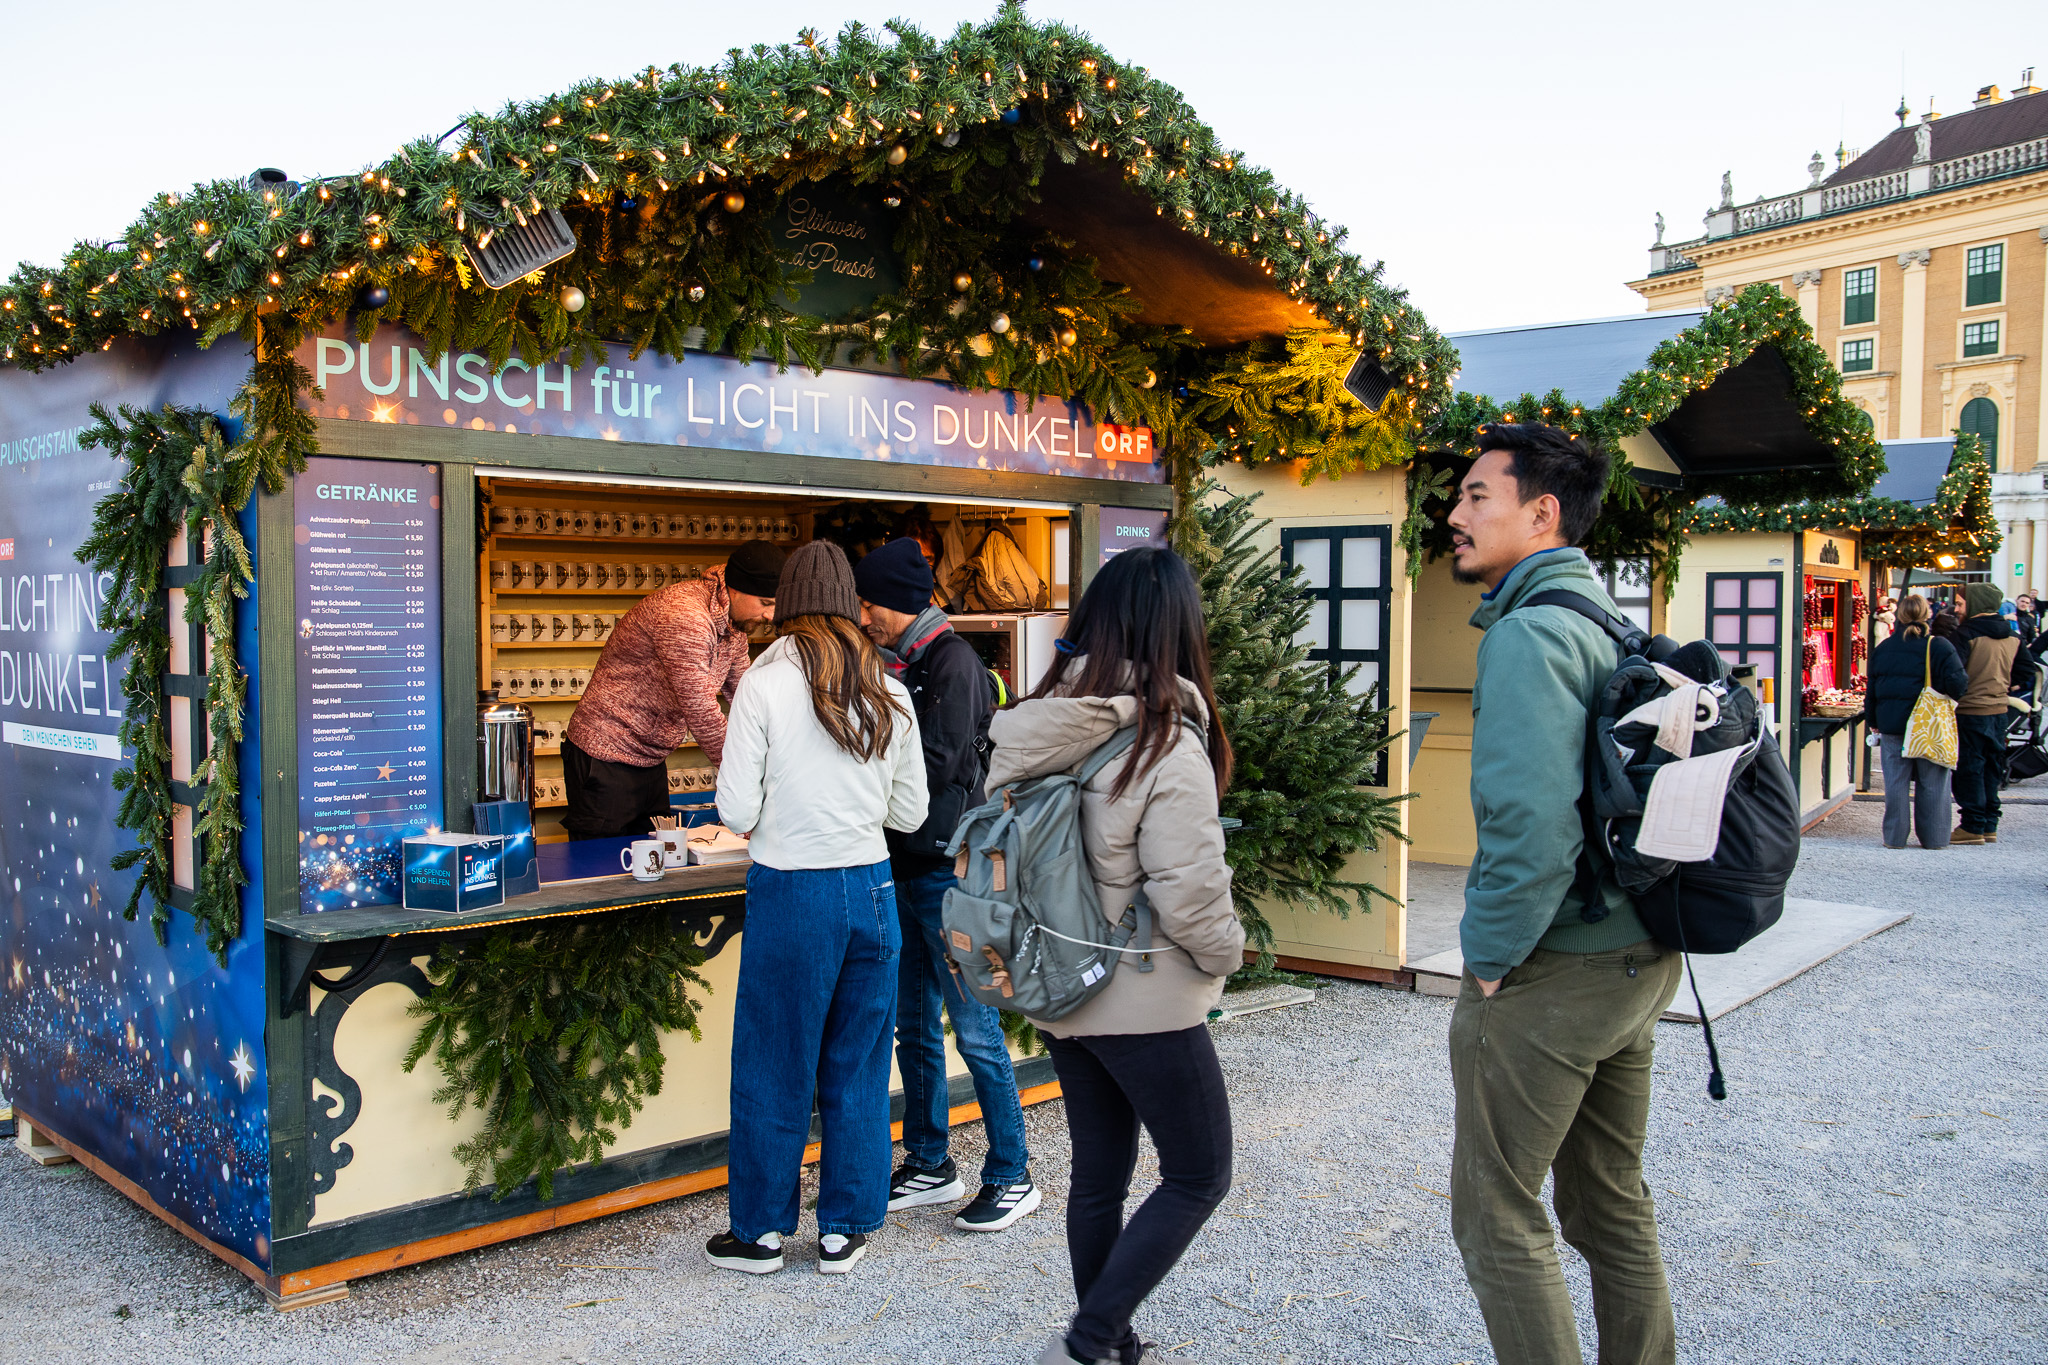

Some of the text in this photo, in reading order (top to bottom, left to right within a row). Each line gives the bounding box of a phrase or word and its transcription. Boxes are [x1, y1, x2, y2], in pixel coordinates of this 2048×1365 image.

[785, 198, 866, 240] Glühwein
[807, 242, 876, 279] Punsch
[316, 337, 1092, 458] PUNSCH für LICHT INS DUNKEL
[1101, 431, 1148, 455] ORF
[316, 483, 418, 503] GETRÄNKE
[310, 516, 349, 525] Adventzauber
[310, 531, 336, 539] Glühwein
[1116, 526, 1150, 538] DRINKS
[0, 542, 14, 556] ORF
[310, 546, 337, 554] Glühwein
[310, 562, 345, 570] Apfelpunsch
[346, 562, 379, 570] (alkoholfrei)
[0, 573, 63, 632] LICHT
[365, 630, 398, 638] Kinderpunsch
[1, 650, 122, 718] DUNKEL
[22, 729, 97, 751] DEN MENSCHEN SEHEN
[315, 809, 351, 817] Häferl-Pfand
[424, 869, 451, 878] SPENDEN
[465, 858, 497, 876] LICHT
[428, 878, 452, 887] HELFEN.
[475, 873, 497, 882] DUNKEL
